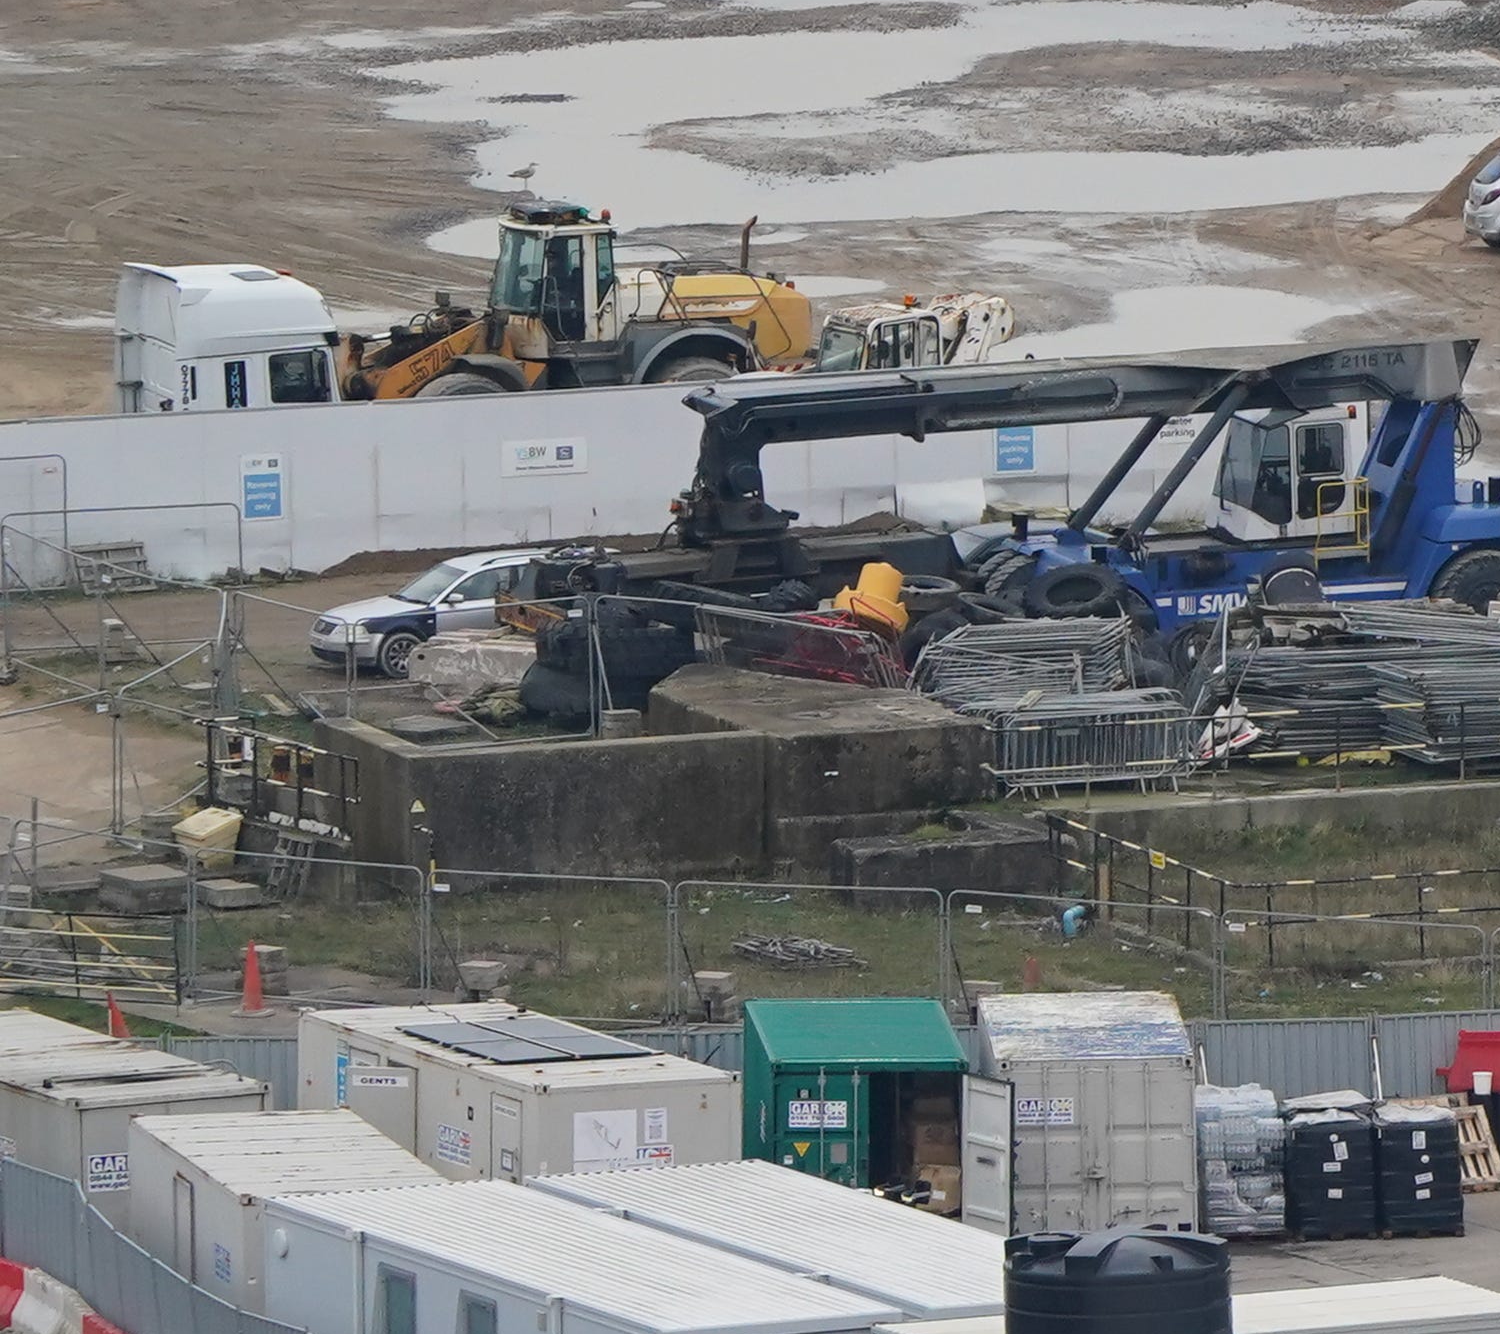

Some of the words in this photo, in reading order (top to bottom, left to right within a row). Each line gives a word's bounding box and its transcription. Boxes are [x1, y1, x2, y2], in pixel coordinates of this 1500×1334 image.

[1382, 352, 1405, 366] TA
[1160, 428, 1196, 439] parking
[1197, 592, 1249, 614] SMV
[360, 1077, 397, 1085] GENTS
[90, 1156, 128, 1173] GAR
